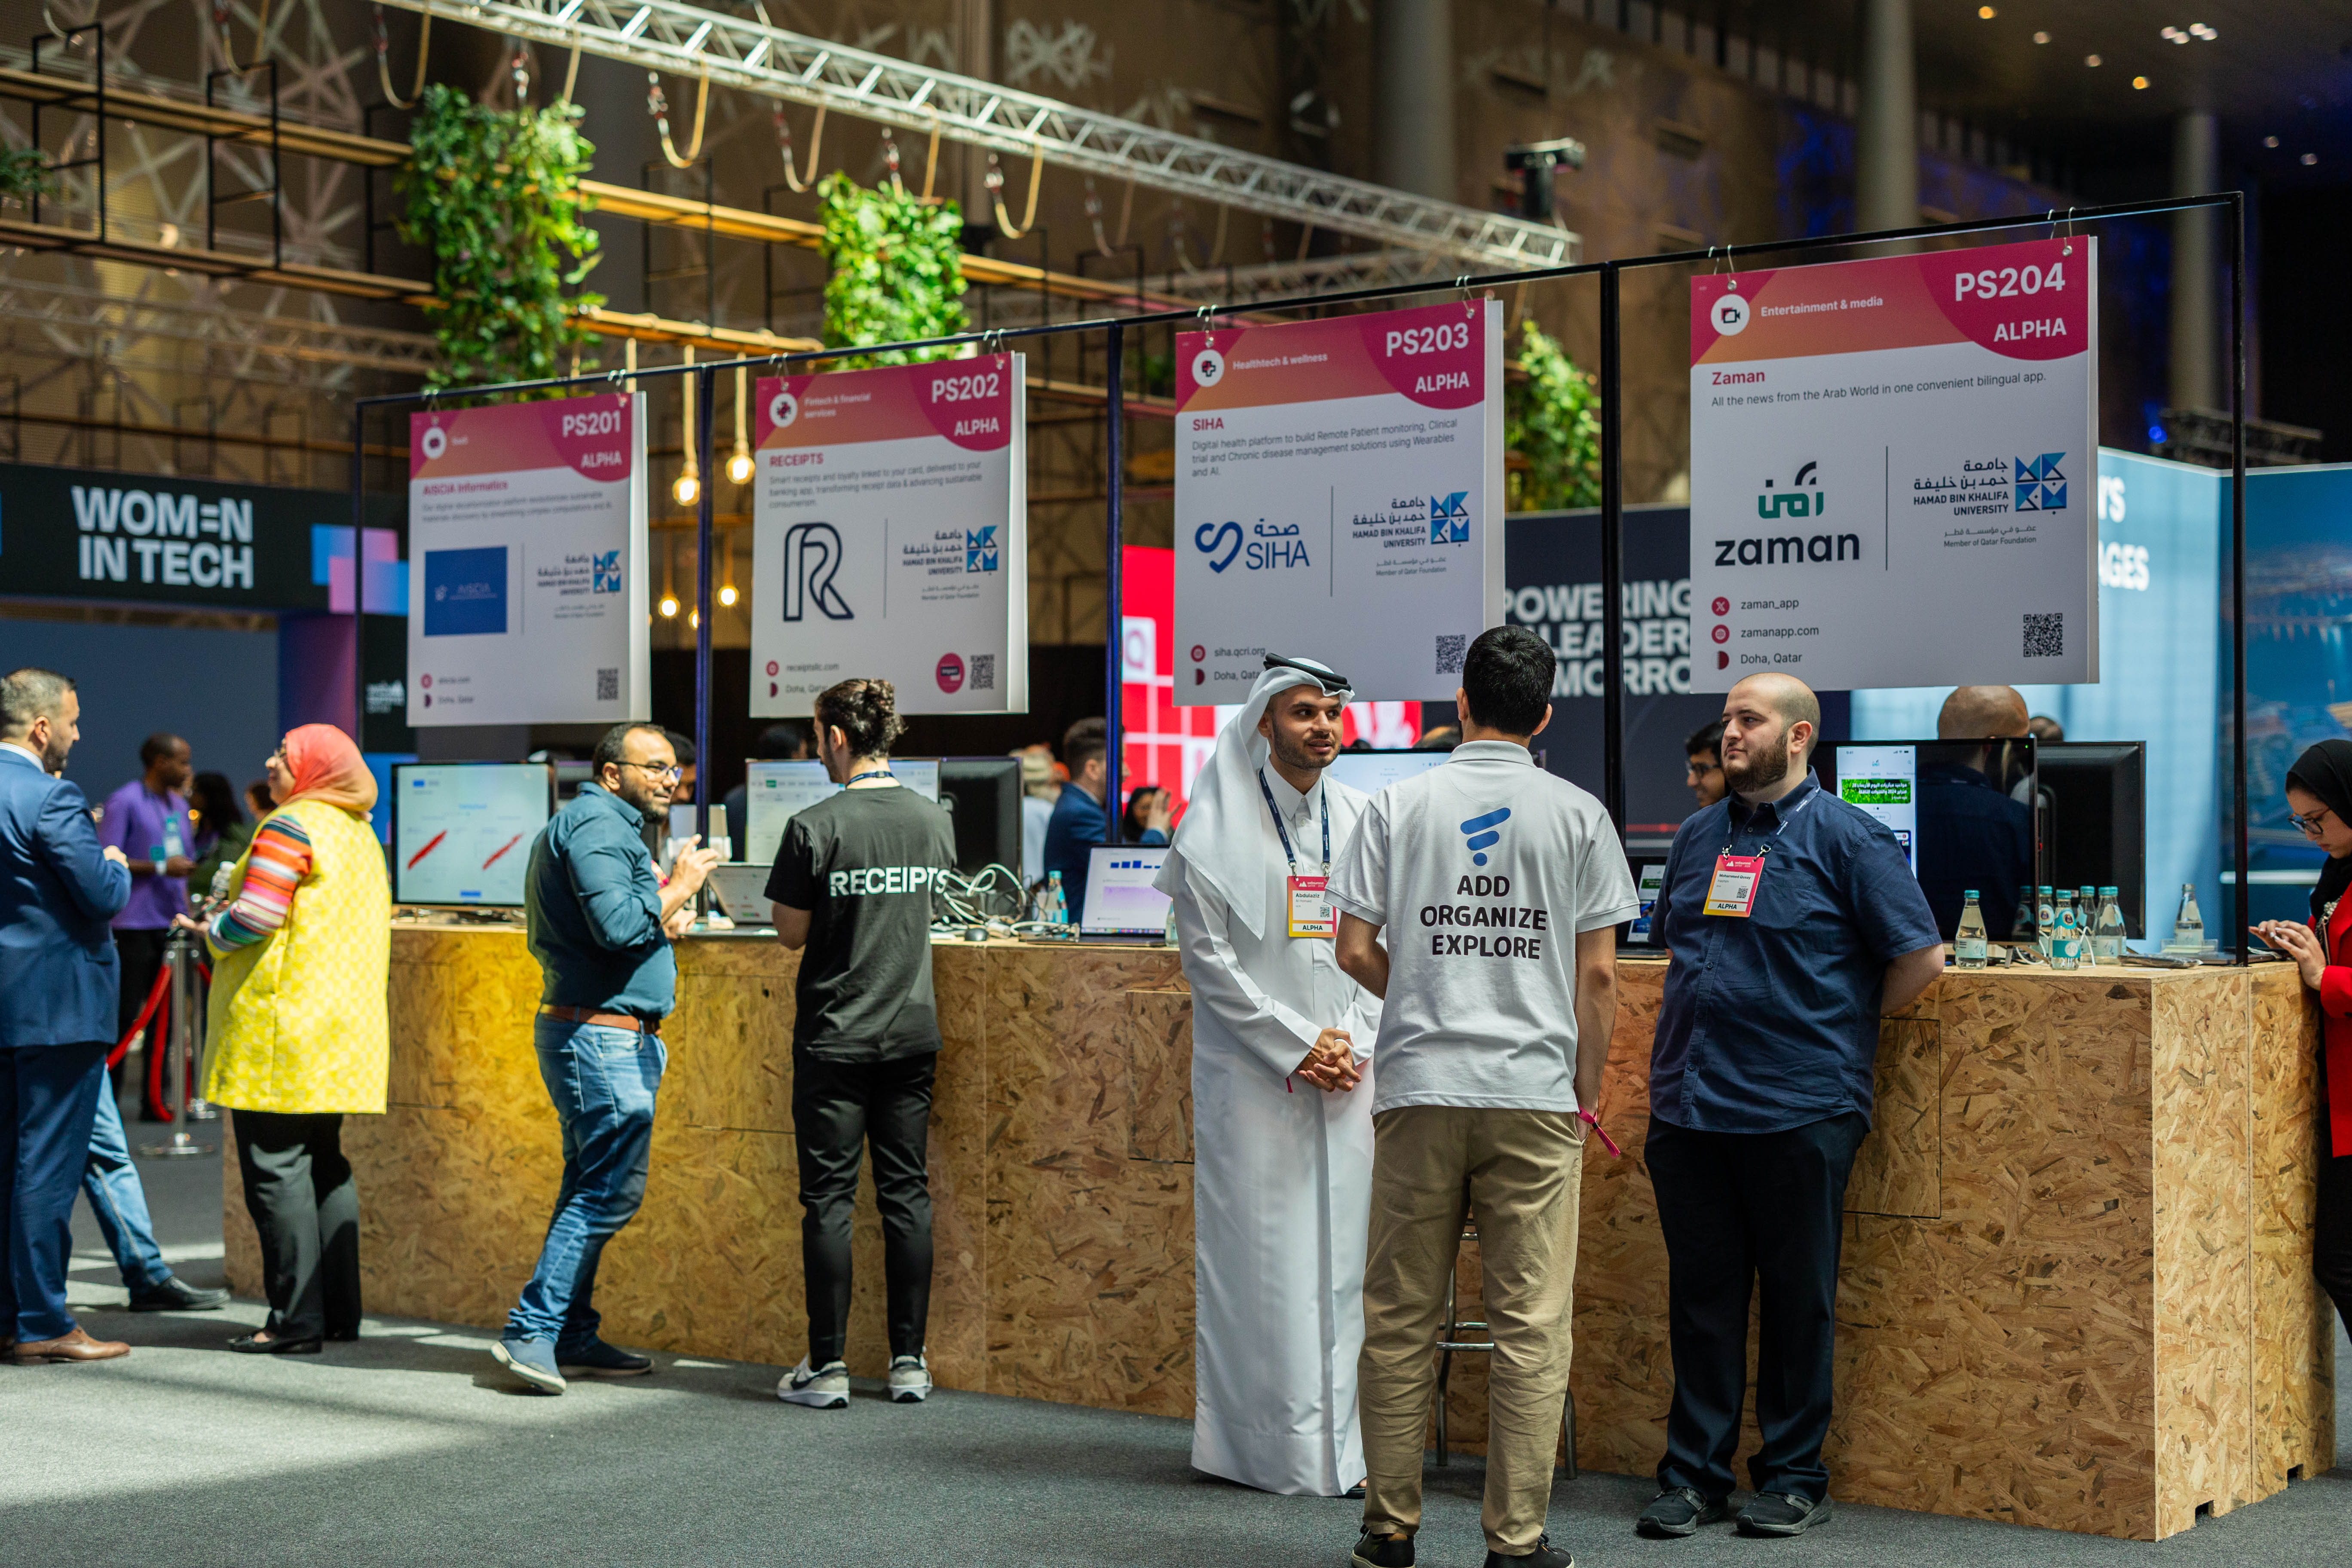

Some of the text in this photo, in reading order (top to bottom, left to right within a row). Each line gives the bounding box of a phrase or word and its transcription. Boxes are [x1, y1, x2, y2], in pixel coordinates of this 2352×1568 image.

[1956, 263, 2065, 301] PS204
[1761, 296, 1883, 317] Entertainment & media
[1387, 322, 1469, 357] PS203
[1994, 318, 2067, 342] ALPHA
[1232, 354, 1328, 370] Healthtech & wellness
[931, 373, 999, 404] PS202
[1415, 371, 1470, 393] ALPHA
[1712, 371, 1765, 386] Zaman
[1712, 372, 2046, 407] All the news from the Arab World in one convenient bilingual app.
[562, 410, 622, 438] PS201
[954, 416, 999, 436] ALPHA
[1193, 417, 1224, 431] SIHA
[1192, 441, 1219, 451] Digital
[1221, 438, 1246, 448] health
[1248, 436, 1283, 447] platform
[1285, 434, 1293, 443] to
[1295, 432, 1315, 442] build
[1317, 430, 1348, 440] Remote
[1351, 427, 1380, 437] Patient
[1428, 419, 1458, 430] Clinical
[1192, 433, 1455, 463] trial and Chronic disease management solutions using Wearables
[581, 450, 622, 469] ALPHA
[769, 452, 824, 467] RECEIPTS
[1964, 457, 2008, 472] جامعة
[1192, 468, 1208, 477] and
[1914, 475, 2008, 492] حمد بن خليفة
[1391, 496, 1426, 509] جامعة
[1914, 492, 2009, 505] HAMAD BIN KHALIFA
[2098, 475, 2125, 523] TS
[1353, 512, 1425, 527] حمد بن خليفة
[1954, 505, 2009, 515] UNIVERSITY
[1254, 518, 1299, 537] صحة
[1353, 526, 1426, 539] HAMAD BIN KHALIFA
[1384, 538, 1426, 548] UNIVERSITY
[1715, 533, 1859, 567] zaman
[2000, 536, 2037, 545] Foundation
[78, 534, 128, 582] IN
[132, 538, 254, 590] TECH
[1246, 540, 1310, 570] SIHA
[784, 522, 854, 622] R
[1741, 600, 1799, 610] zaman_app
[1741, 627, 1819, 638] zamanapp.com
[1214, 647, 1266, 658] siha.qcri.org
[1741, 653, 1802, 665] Doha, Qatar
[1214, 670, 1261, 681] Doha, Qata
[1550, 656, 1690, 698] MORRO
[830, 866, 950, 897] RECEIPTS
[1457, 875, 1510, 897] ADD
[1420, 905, 1547, 931] ORGANIZE
[1432, 934, 1541, 959] EXPLORE
